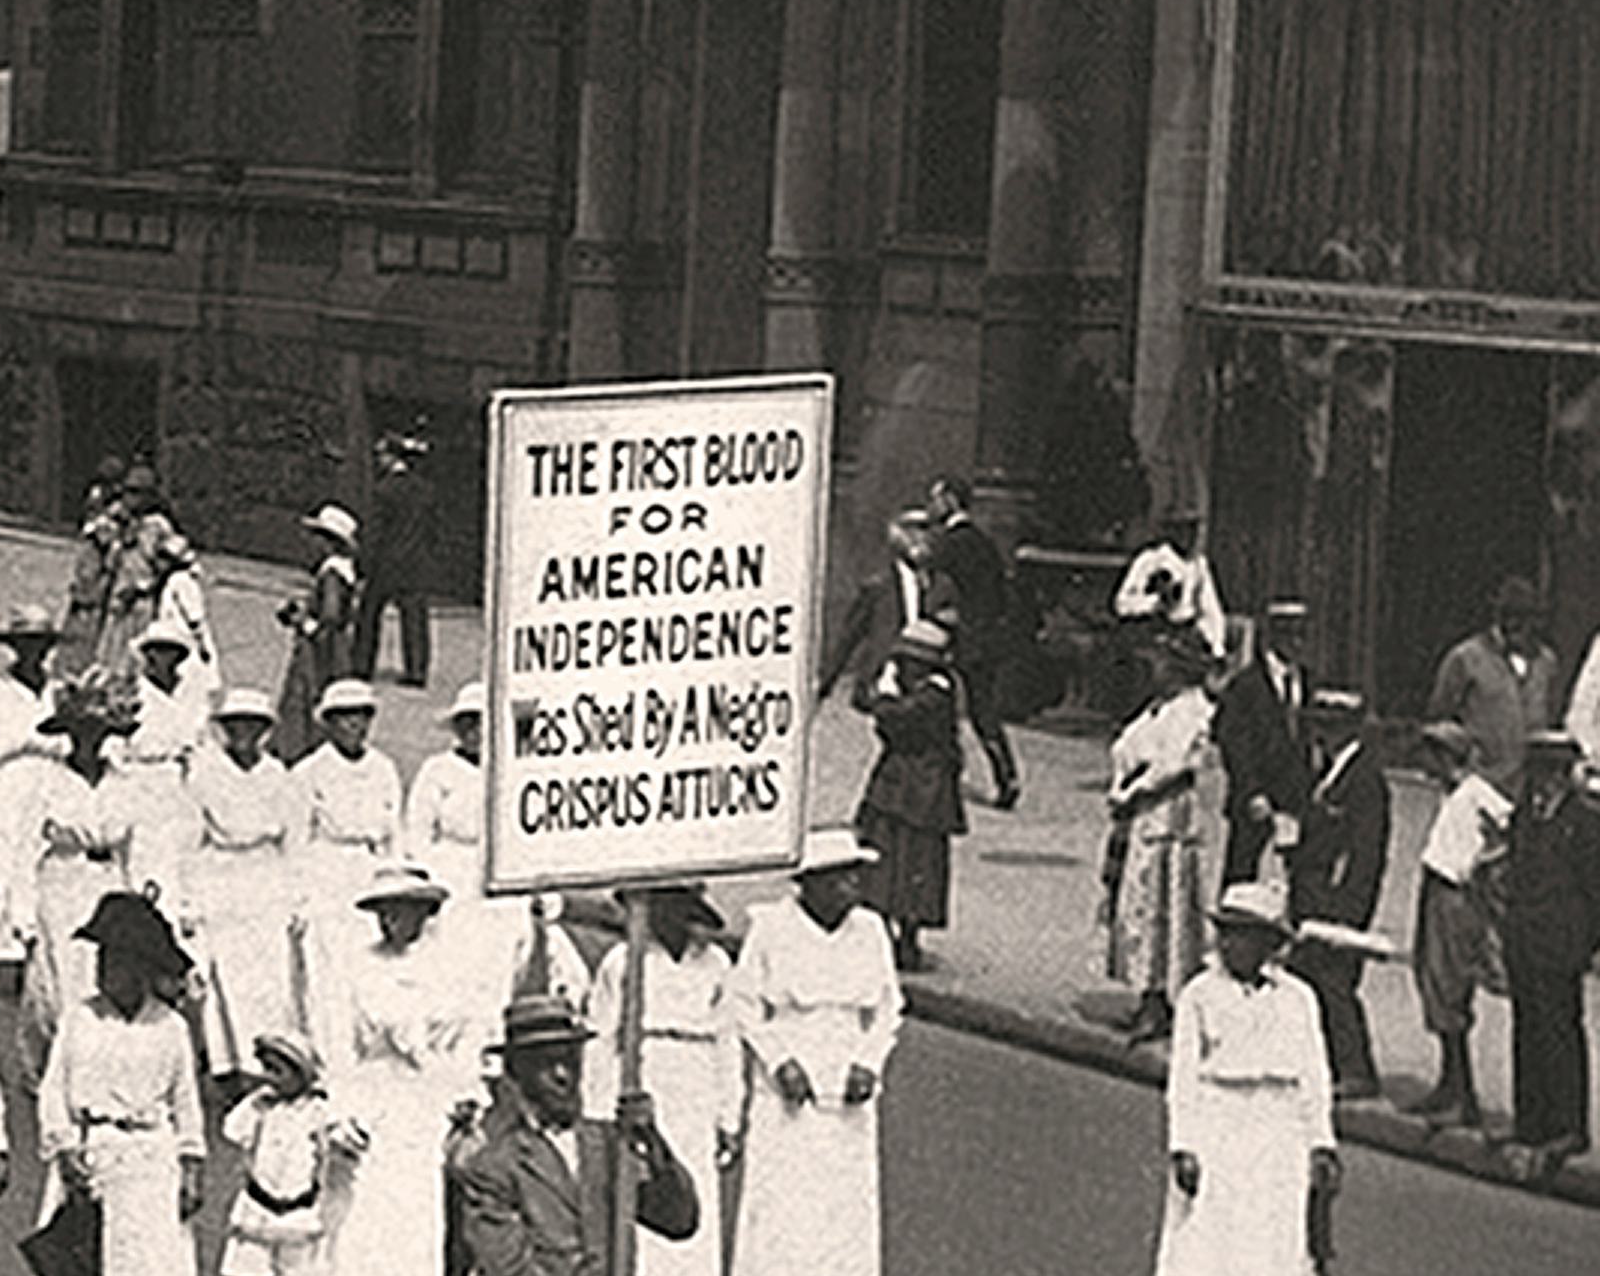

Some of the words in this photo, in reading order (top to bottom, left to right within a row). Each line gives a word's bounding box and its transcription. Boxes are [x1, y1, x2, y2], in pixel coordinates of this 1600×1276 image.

[526, 440, 598, 497] THE
[609, 436, 697, 492] FIRST
[704, 429, 804, 487] BLOOD
[608, 502, 709, 535] FOR
[538, 544, 765, 604] AMERICAN
[512, 605, 794, 674] INDEPENDENCE
[510, 699, 568, 760] Was
[572, 689, 636, 756] Shed
[644, 687, 678, 759] By
[678, 685, 701, 746] A
[706, 681, 793, 754] Negro
[518, 772, 652, 835] CRISPUS
[656, 760, 781, 822] ATTUCKS
